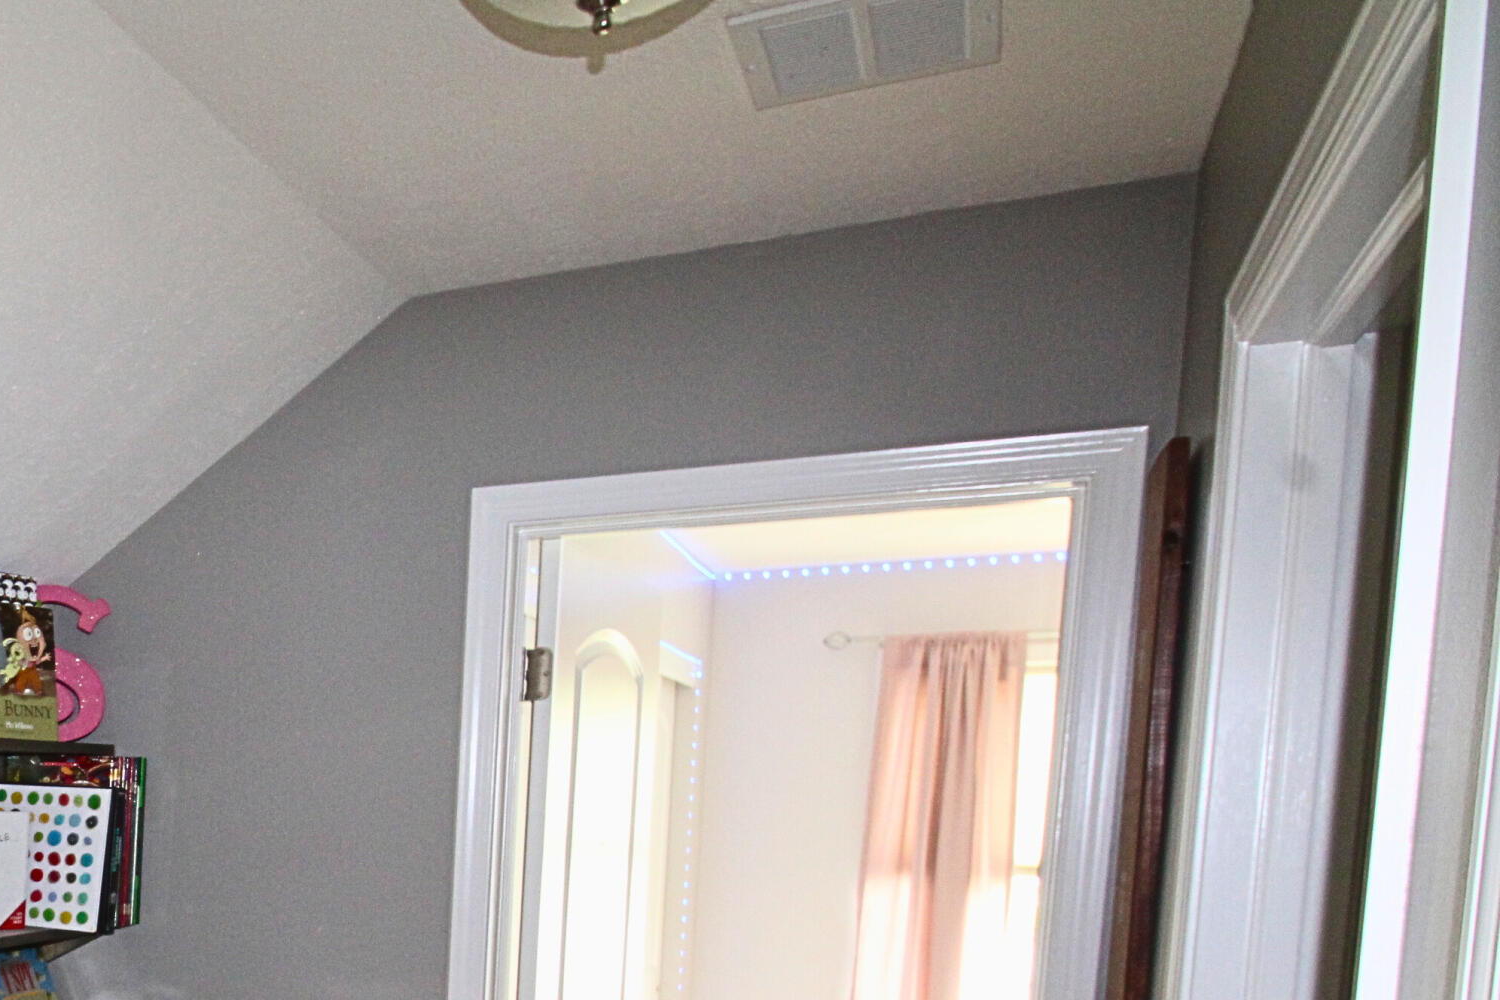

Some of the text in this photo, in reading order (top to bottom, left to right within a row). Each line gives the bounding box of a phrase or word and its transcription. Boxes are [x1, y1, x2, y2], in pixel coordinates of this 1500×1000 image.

[4, 699, 52, 720] BUNNY
[0, 962, 36, 994] I SPY
